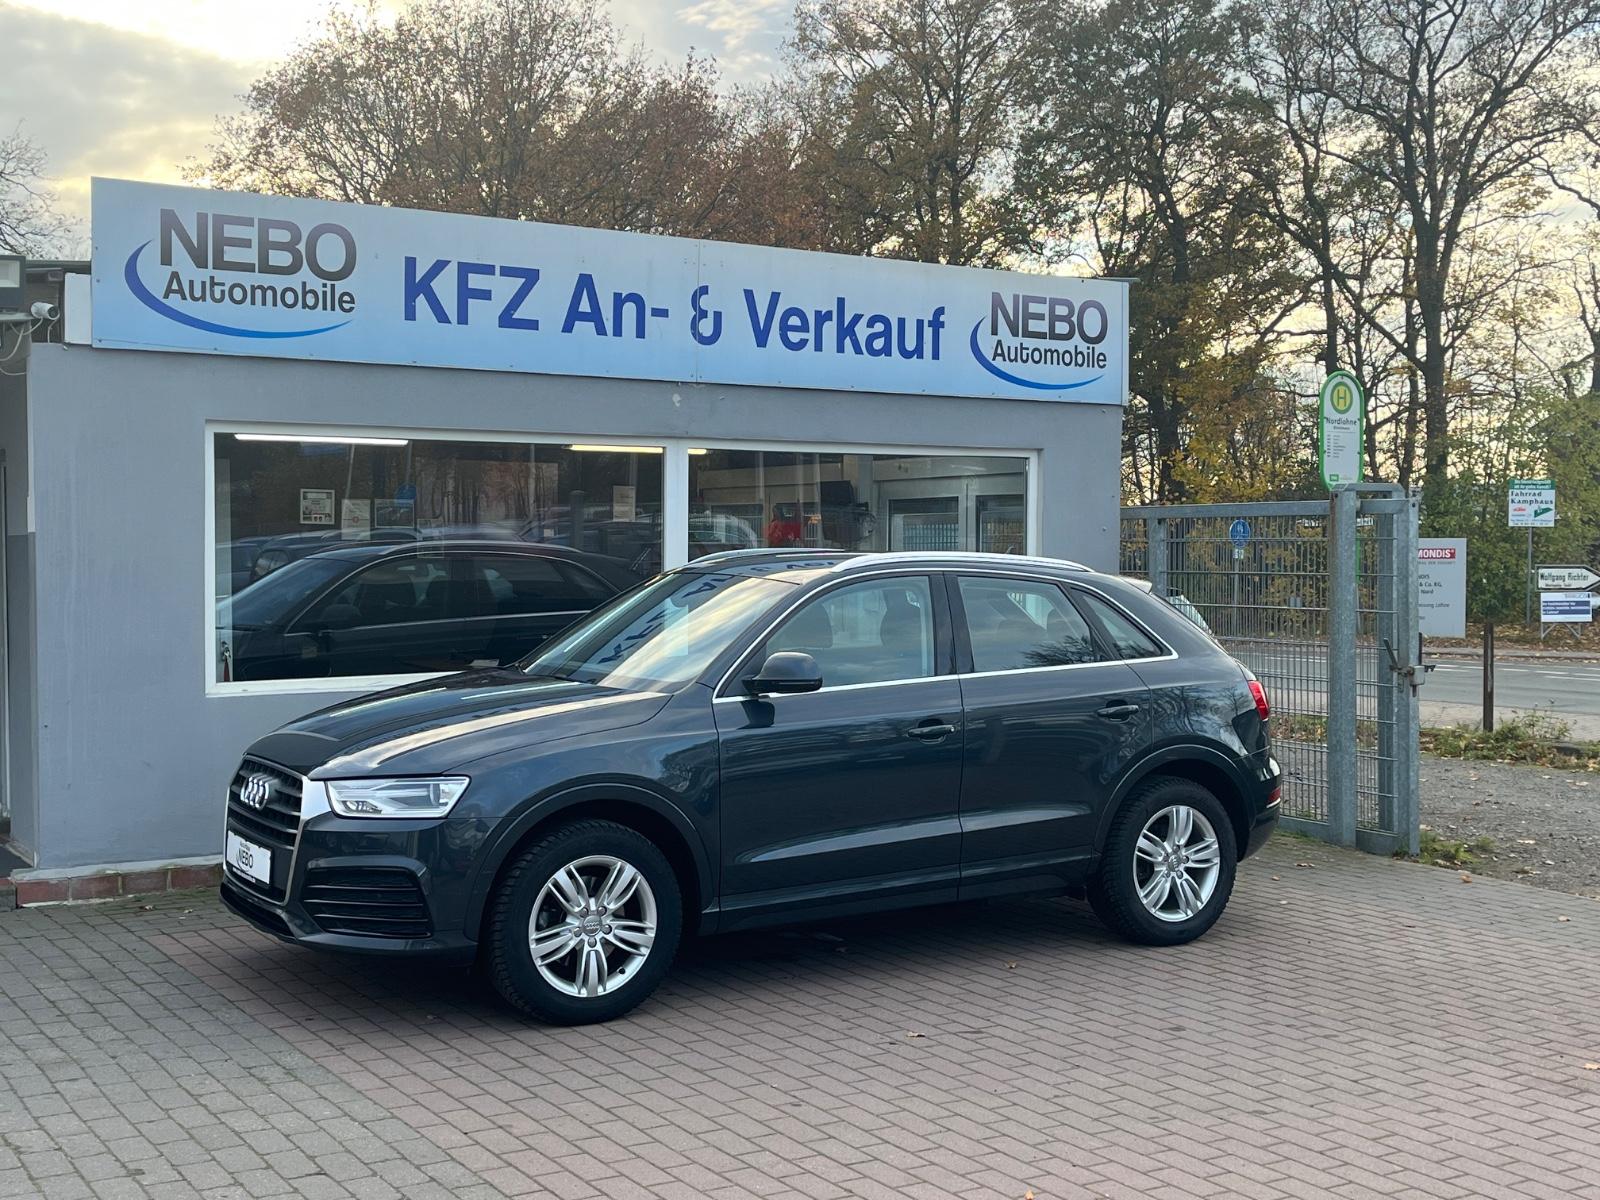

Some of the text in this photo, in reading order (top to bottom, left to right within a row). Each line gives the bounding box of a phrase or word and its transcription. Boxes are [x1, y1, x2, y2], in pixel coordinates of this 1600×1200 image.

[160, 208, 357, 281] NEBO
[163, 270, 355, 313] Automobile
[404, 256, 945, 360] KFZ An- & Verkauf
[991, 292, 1108, 345] NEBO
[992, 339, 1107, 369] Automobile
[1326, 417, 1357, 426] Nordlohne
[1511, 498, 1553, 506] Kamphaus
[1417, 549, 1451, 558] MONDIS
[1540, 572, 1566, 582] Wolfgang
[239, 847, 254, 868] NEBO
